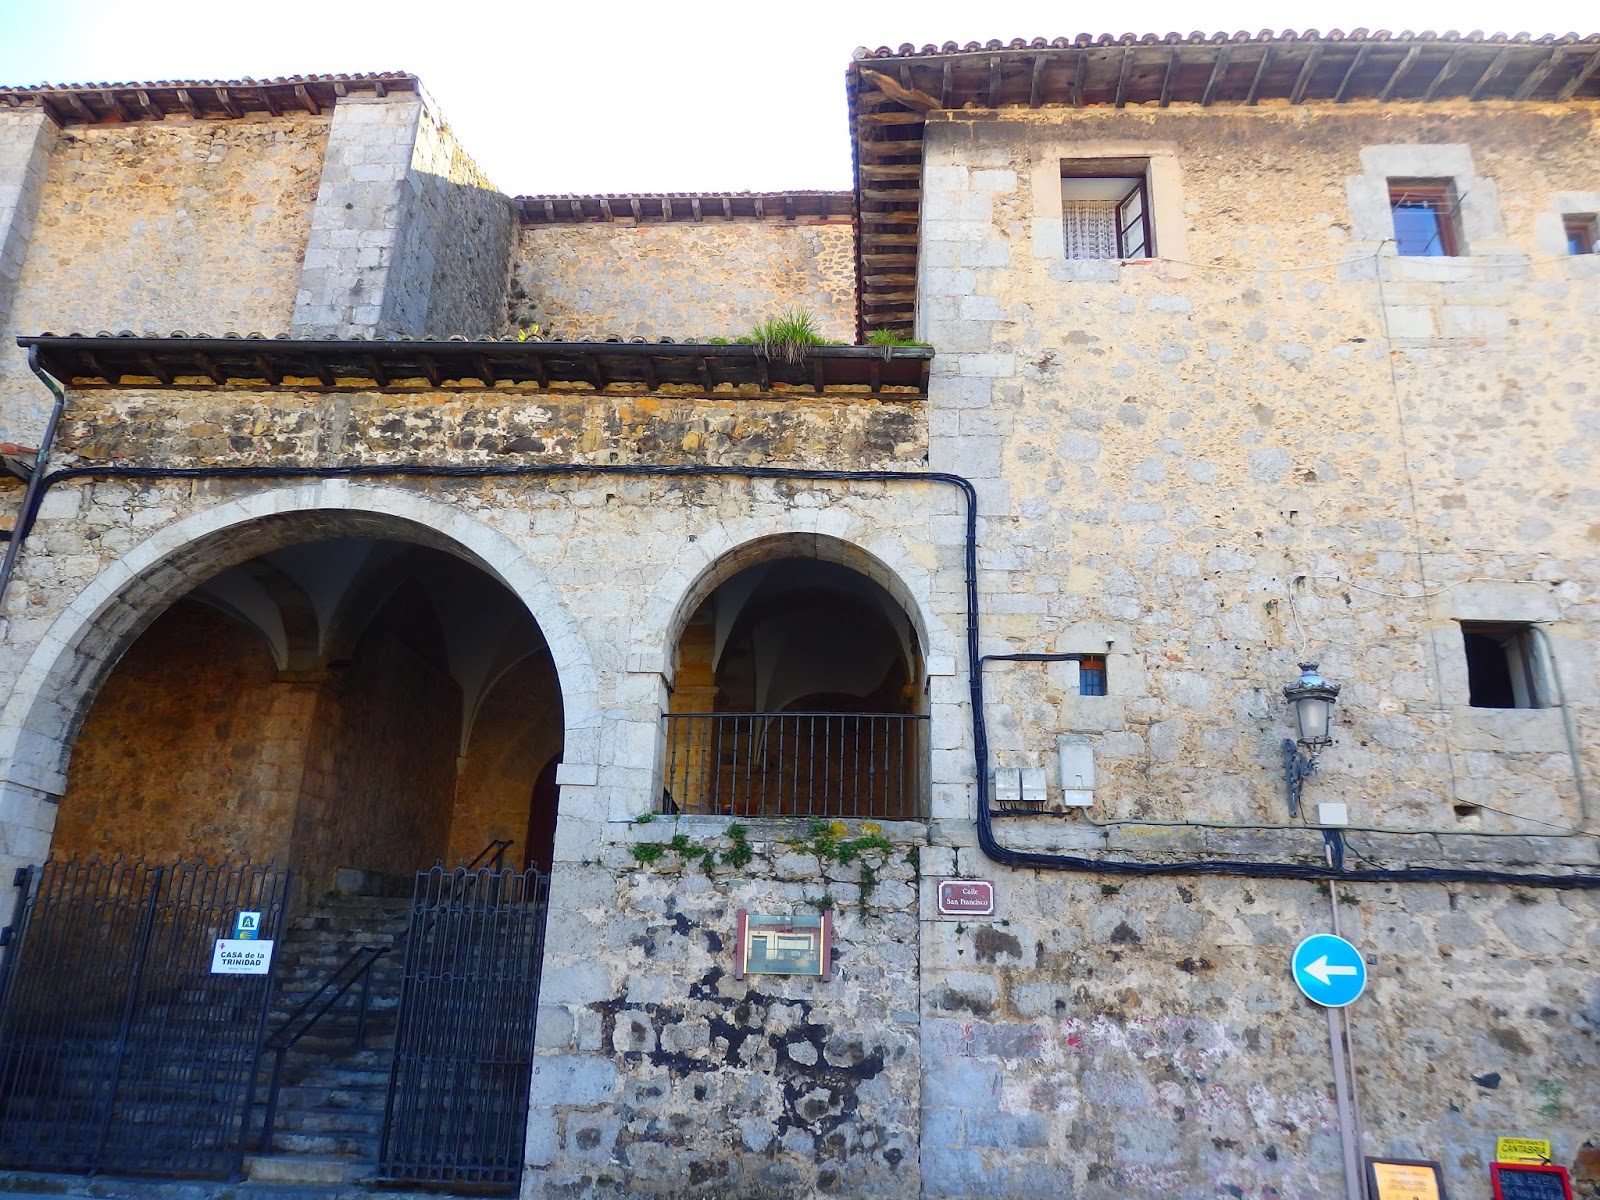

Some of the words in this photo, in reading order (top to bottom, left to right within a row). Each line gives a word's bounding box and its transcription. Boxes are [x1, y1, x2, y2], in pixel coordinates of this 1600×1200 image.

[960, 898, 988, 906] Francisco
[220, 951, 243, 959] CASA
[222, 959, 262, 967] TRINIDAD
[1501, 1144, 1546, 1154] CANTABRIA
